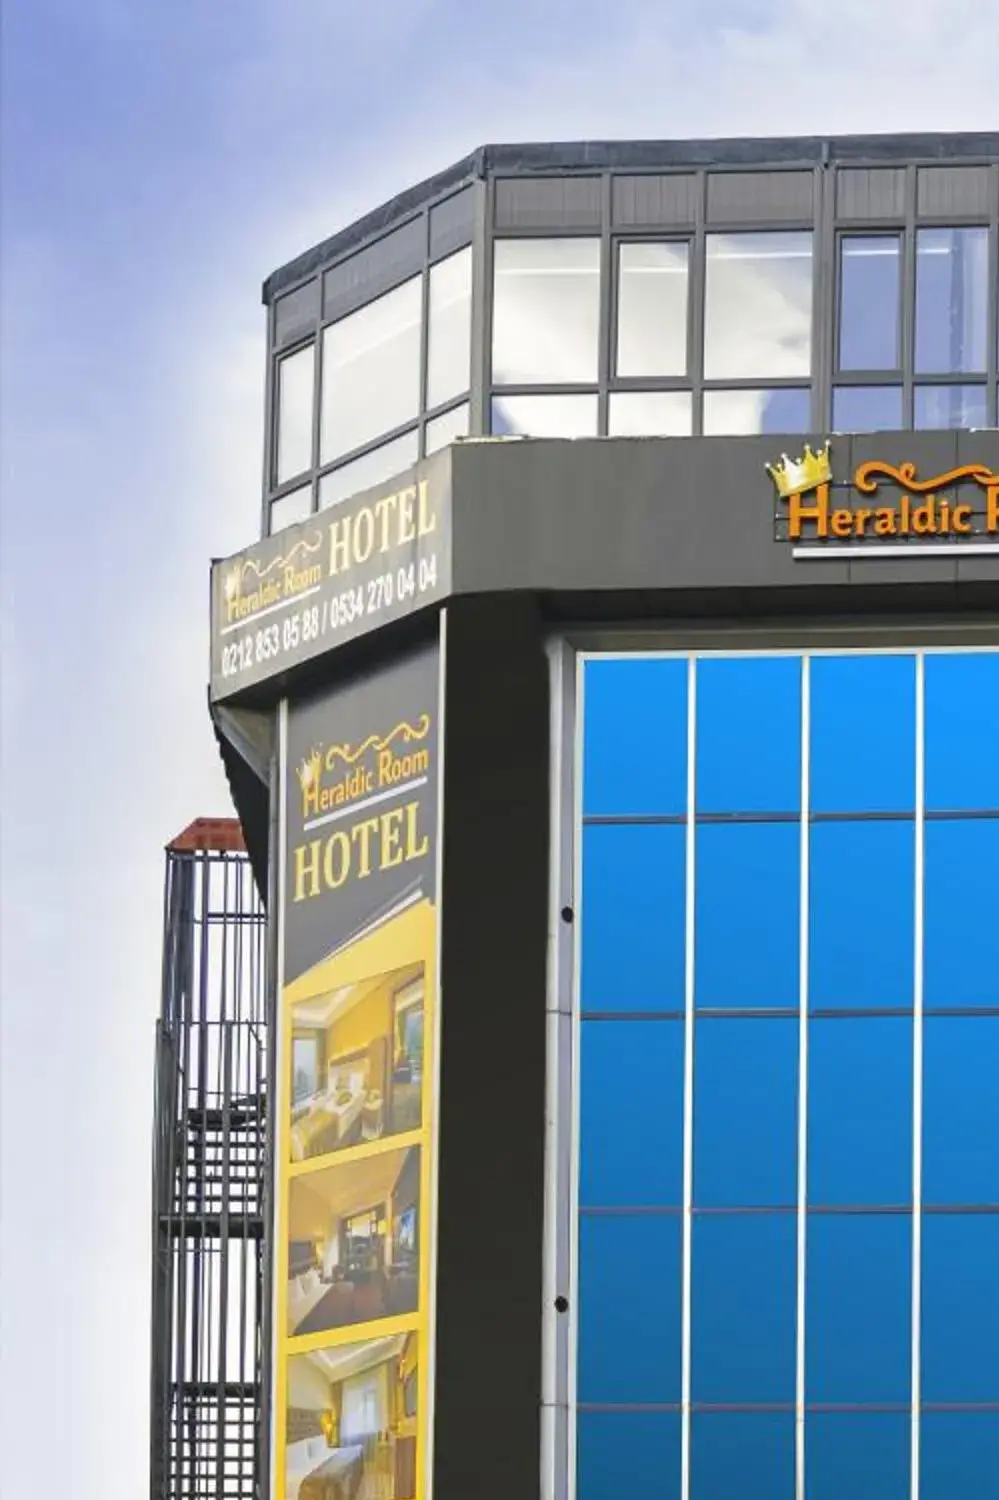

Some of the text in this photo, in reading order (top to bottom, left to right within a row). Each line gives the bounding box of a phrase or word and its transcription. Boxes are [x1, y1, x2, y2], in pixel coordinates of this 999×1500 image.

[284, 564, 322, 597] Room
[329, 479, 437, 577] HOTEL
[788, 482, 973, 538] Heraldic
[222, 635, 253, 678] 0212
[255, 623, 280, 662] 853
[283, 615, 300, 652] 05
[302, 604, 319, 641] 88
[330, 585, 364, 629] 0534
[367, 572, 393, 614] 270
[397, 563, 415, 600] 04
[419, 553, 437, 592] 04
[303, 748, 429, 819] Heraldic Room
[293, 801, 429, 902] HOTEL
